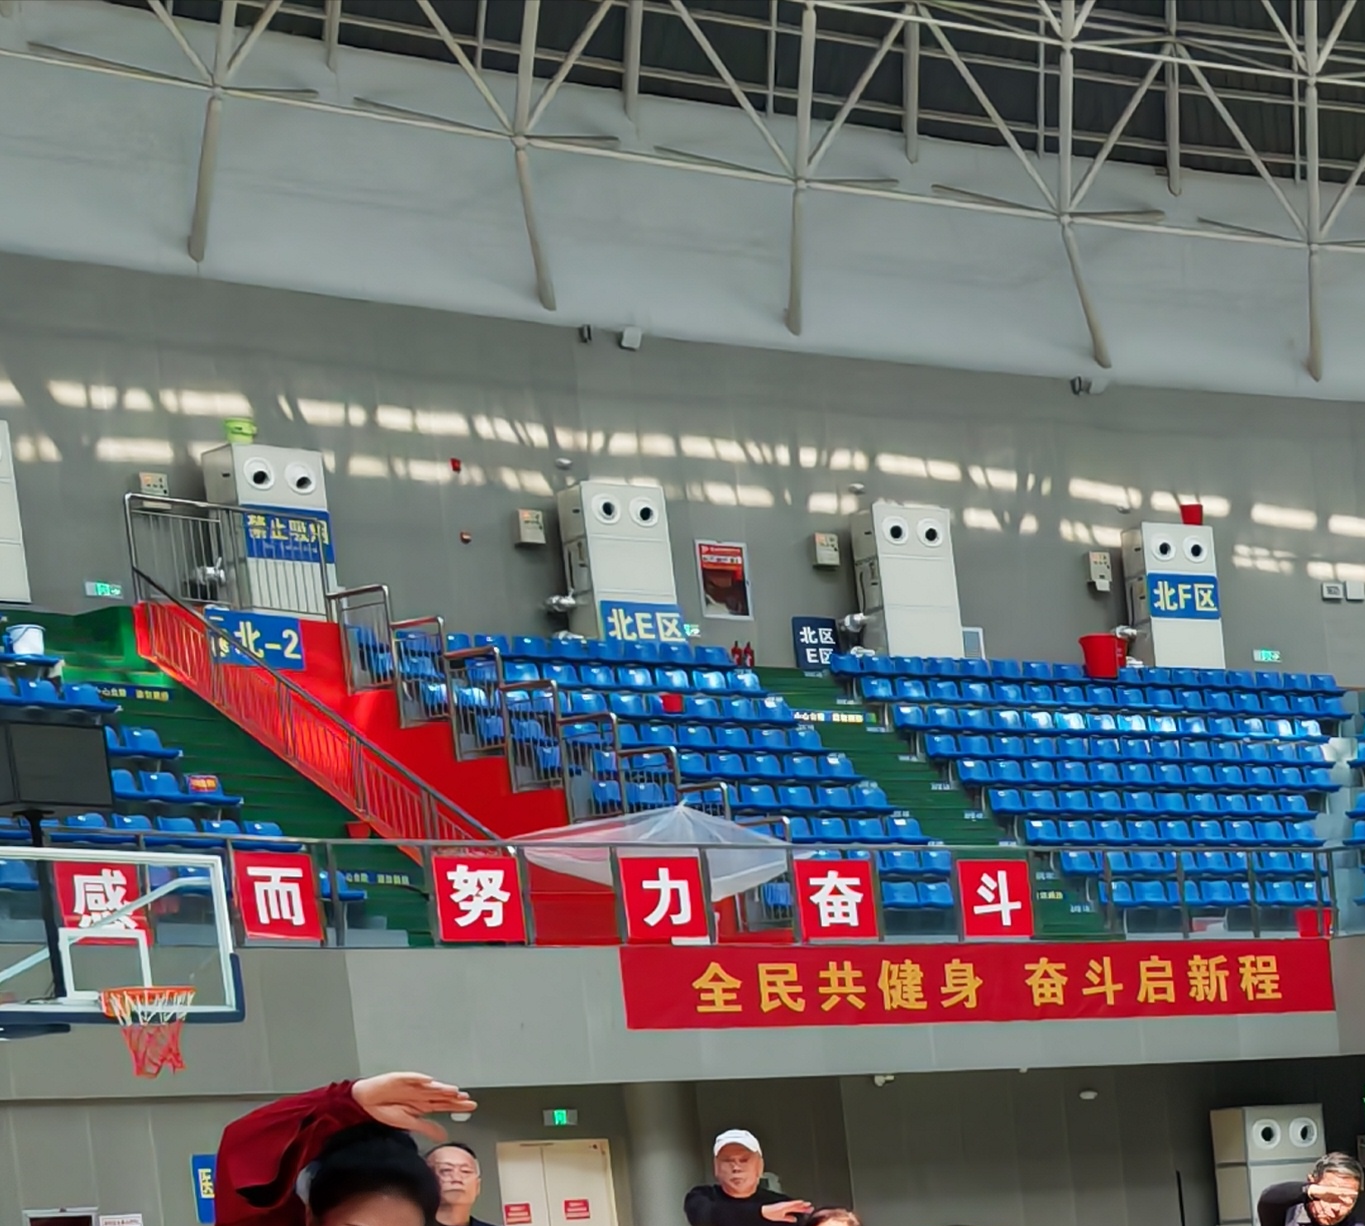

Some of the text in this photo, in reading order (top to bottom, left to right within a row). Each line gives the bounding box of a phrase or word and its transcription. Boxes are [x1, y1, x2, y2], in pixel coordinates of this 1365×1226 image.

[607, 608, 686, 641] 北E区
[1153, 580, 1218, 612] 北F区
[800, 626, 836, 645] 北区
[806, 648, 834, 665] E区
[73, 869, 137, 930] 感
[246, 866, 306, 926] 而
[447, 864, 510, 928] 努
[641, 868, 692, 926] 力
[808, 870, 864, 927] 奋
[973, 871, 1021, 927] 斗
[692, 955, 1283, 1013] 全民共健身 奋斗启新程
